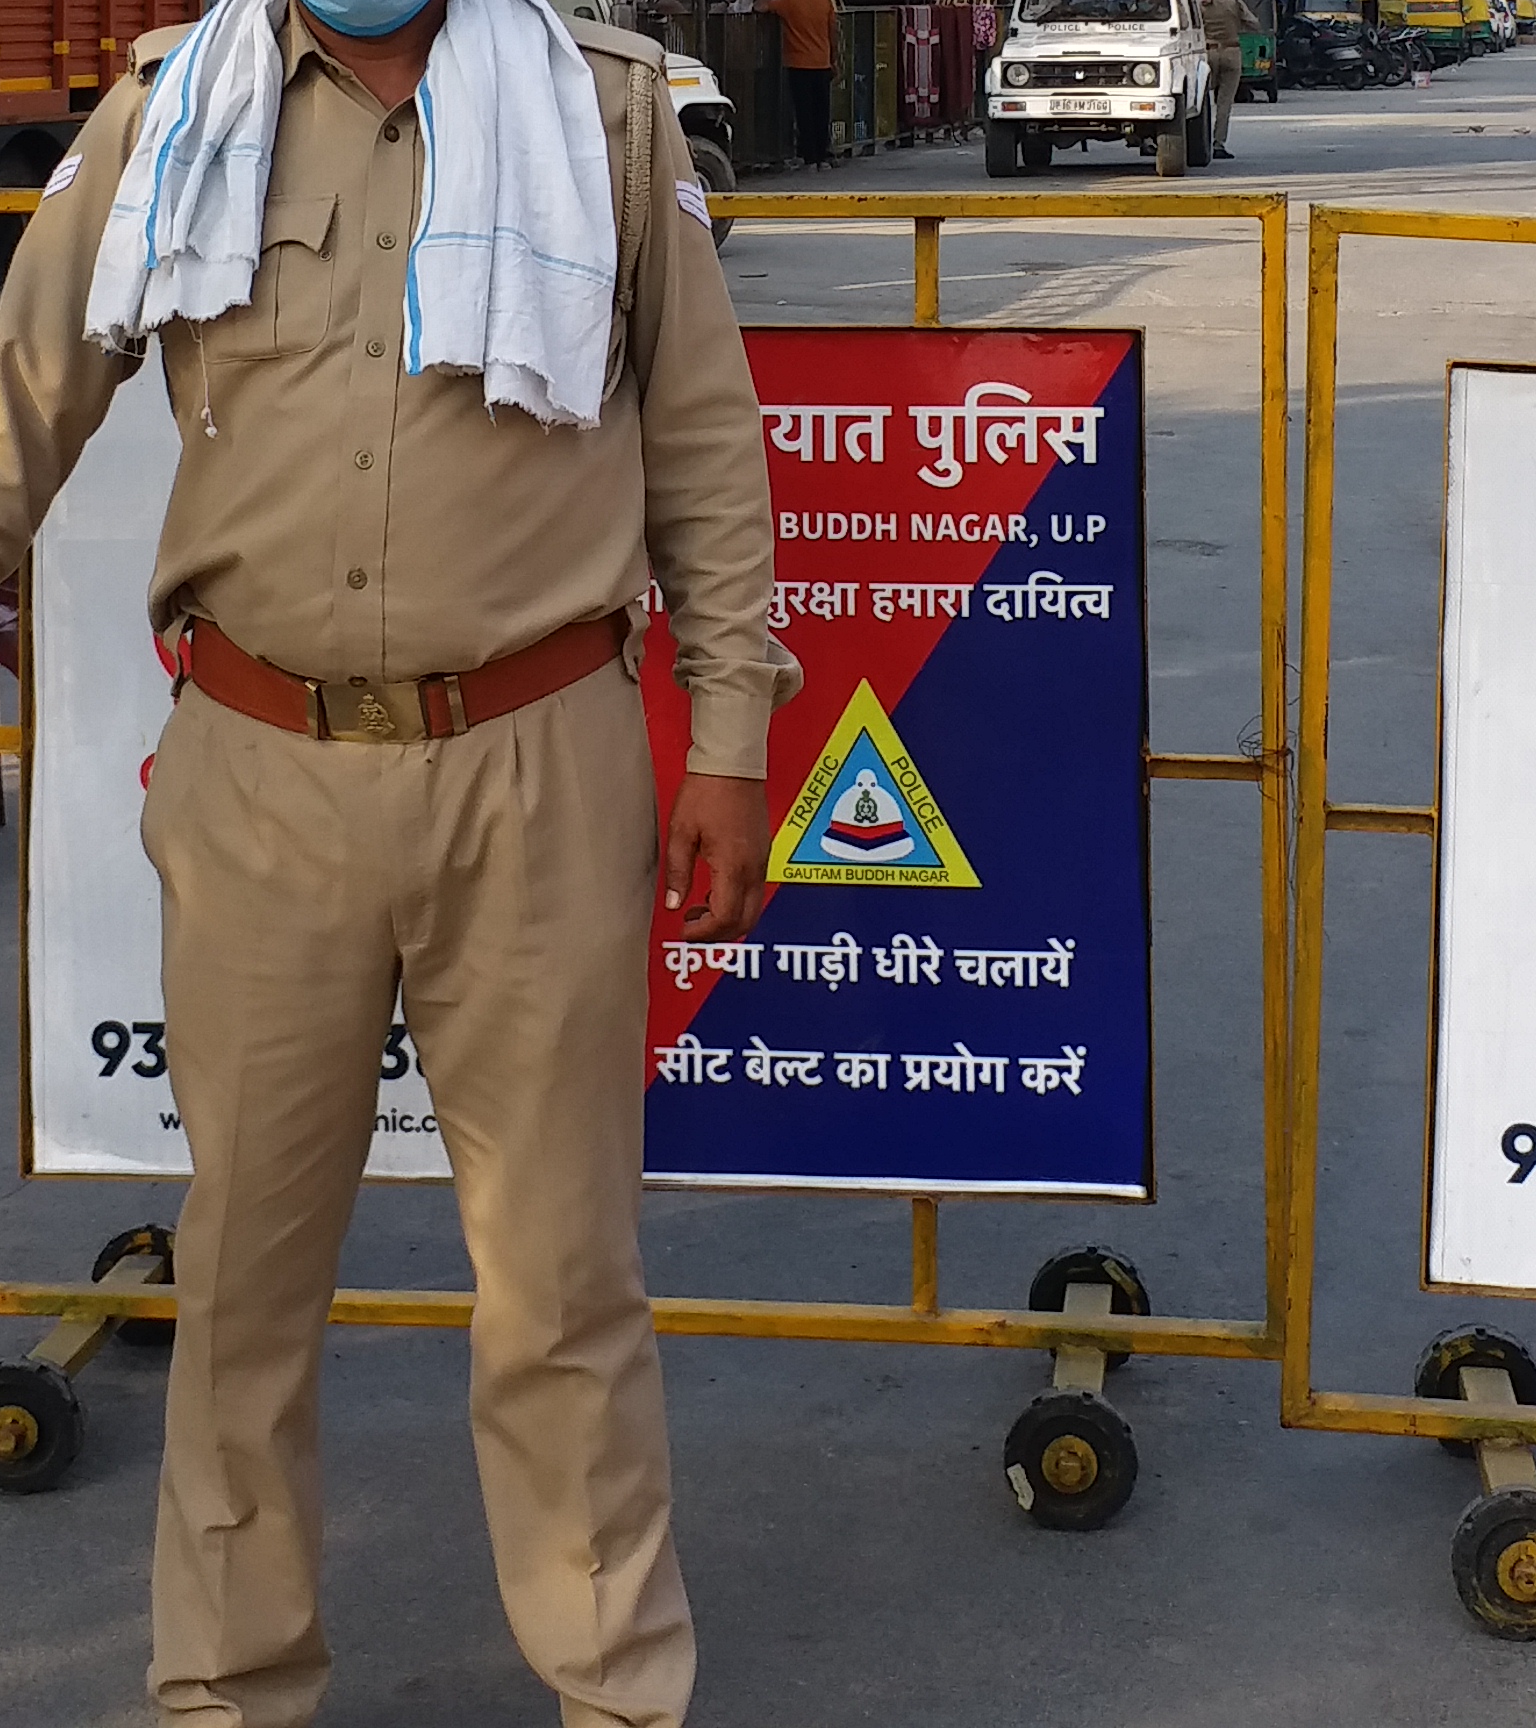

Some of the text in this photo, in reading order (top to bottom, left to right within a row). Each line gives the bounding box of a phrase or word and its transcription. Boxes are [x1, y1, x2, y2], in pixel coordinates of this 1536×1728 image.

[1043, 24, 1081, 32] POLICE
[1107, 23, 1146, 32] POLICE
[909, 382, 1104, 488] पुलिस
[779, 511, 1106, 548] BUDDH NAGAR, U.P
[869, 582, 974, 622] हमारा
[983, 570, 1114, 621] दायित्व
[787, 754, 839, 831] TRAFFIC
[890, 755, 945, 834] POLICE
[783, 867, 950, 883] GAUTAM BUDDH NAGAR
[663, 931, 1077, 992] कृप्या गाड़ी धीरे चलायें
[654, 1033, 1088, 1095] सीट बेल्ट का प्रयोग करें
